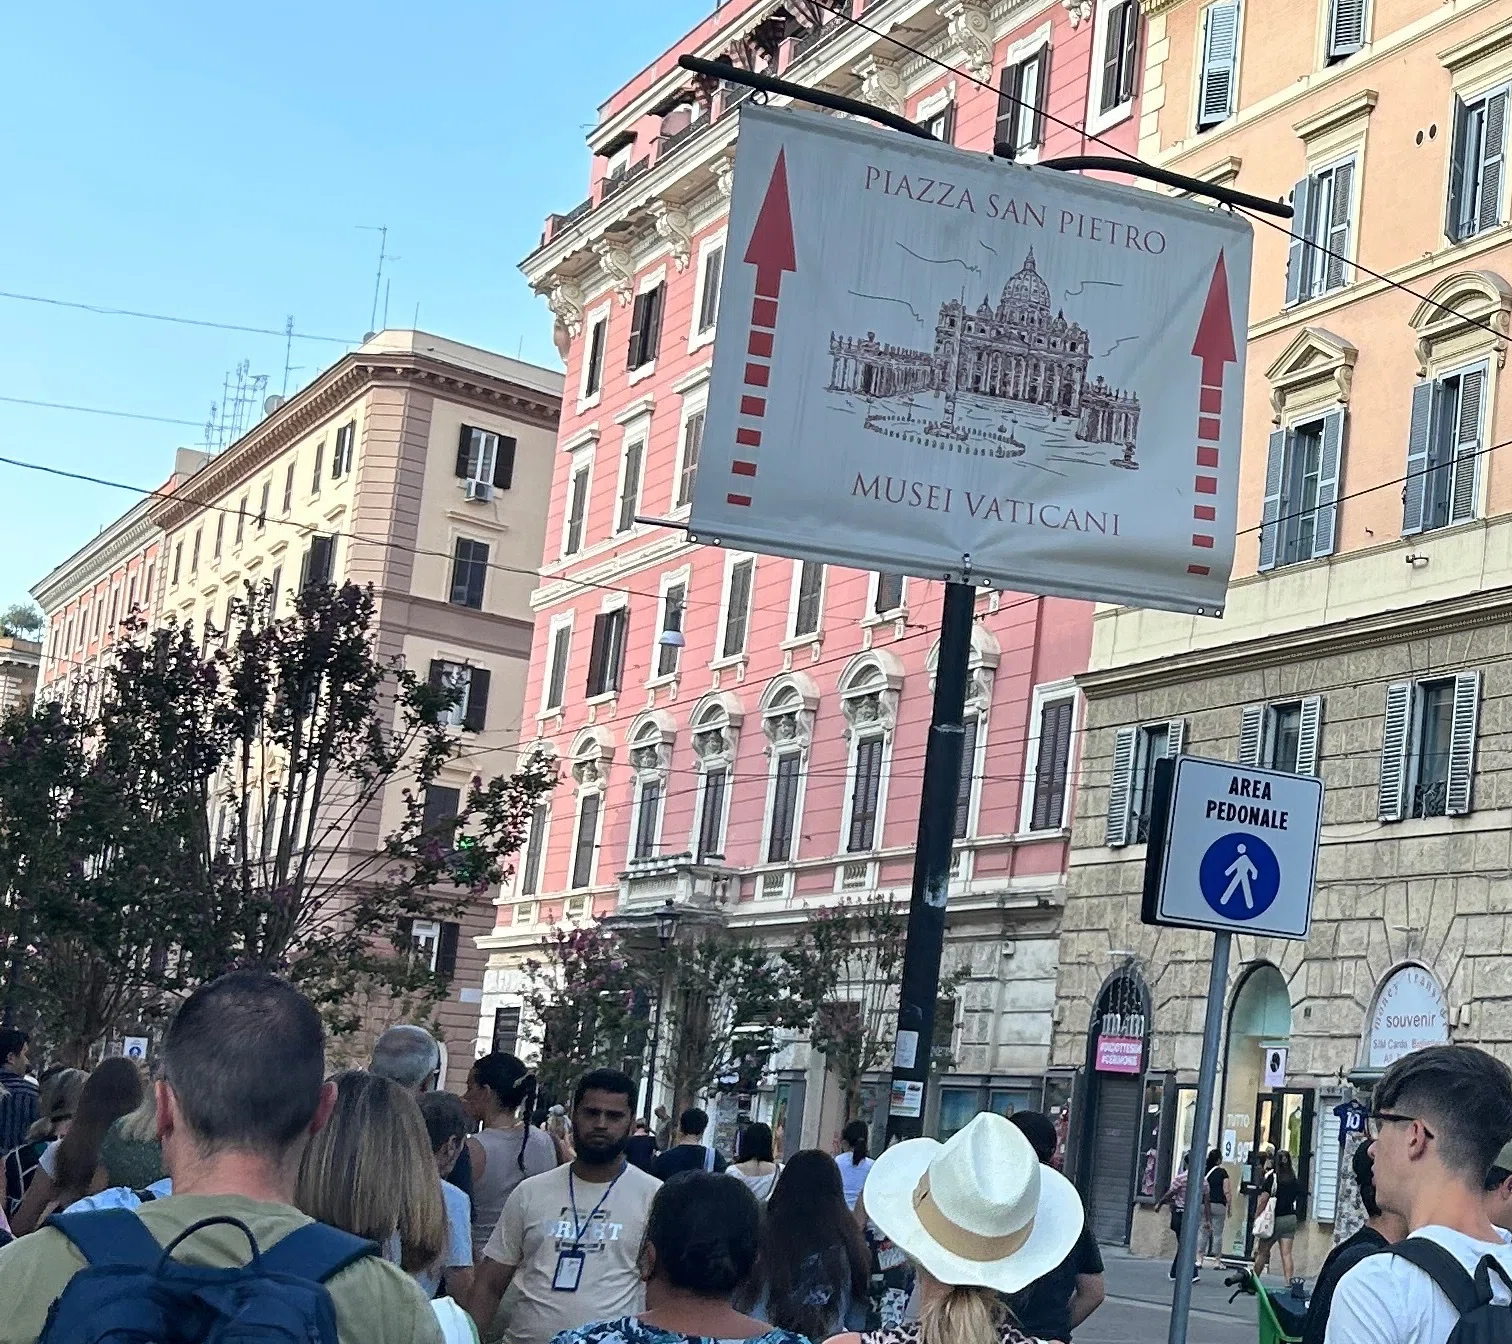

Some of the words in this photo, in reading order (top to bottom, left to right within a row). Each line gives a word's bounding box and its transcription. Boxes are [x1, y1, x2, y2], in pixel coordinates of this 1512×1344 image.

[864, 164, 976, 213] PIAZZA
[988, 193, 1047, 228] SAN
[1058, 210, 1168, 256] PIETRO
[850, 471, 954, 514] MUSEI
[965, 490, 1122, 537] VATICANI
[1227, 775, 1273, 801] AREA
[1204, 799, 1290, 832] PEDONALE
[1386, 1010, 1437, 1028] souvenir
[1345, 1111, 1361, 1130] 10
